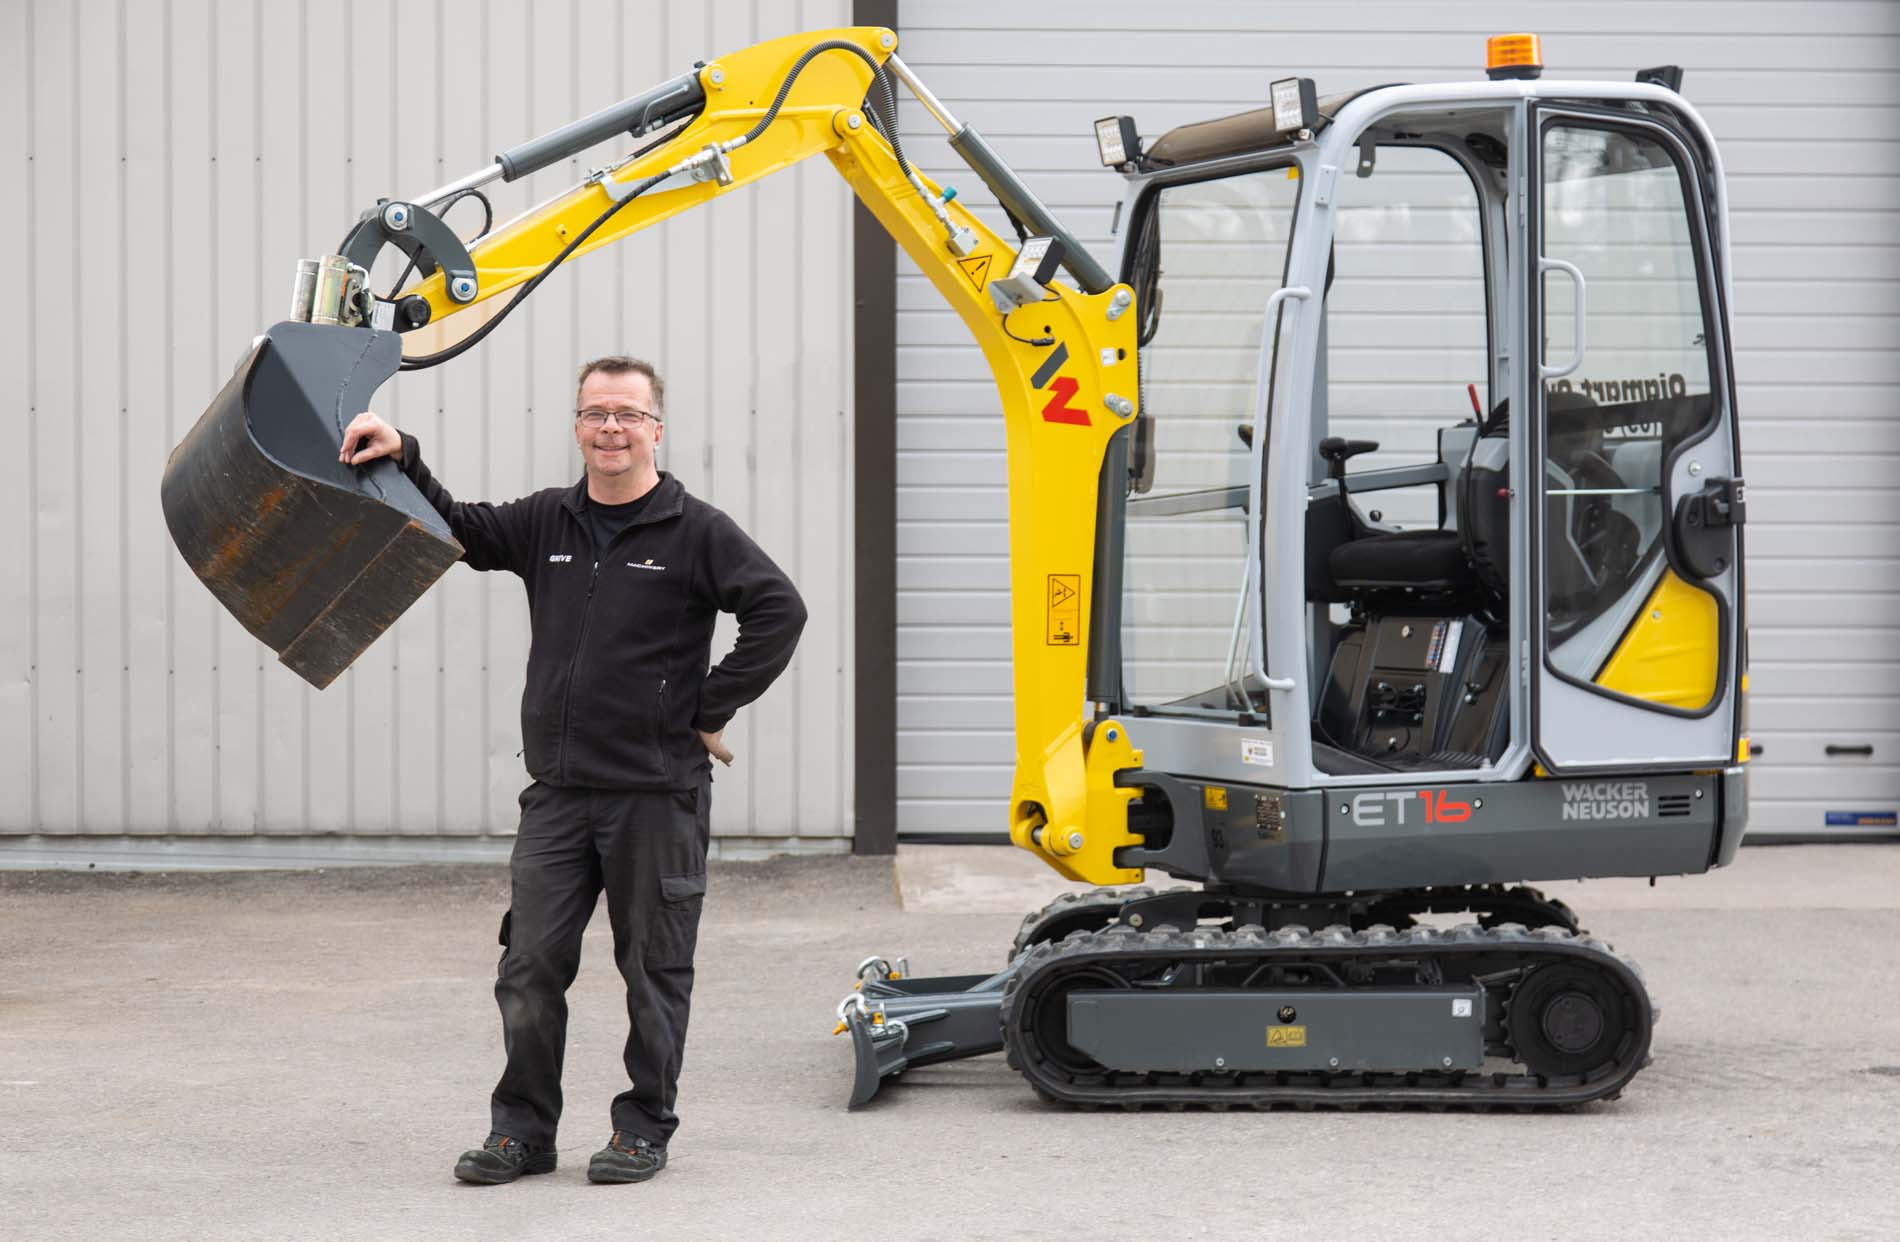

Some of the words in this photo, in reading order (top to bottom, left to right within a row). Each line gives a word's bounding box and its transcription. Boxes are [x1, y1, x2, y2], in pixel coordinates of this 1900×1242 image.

[1561, 783, 1649, 801] WACKER
[1353, 789, 1472, 826] ET16
[1562, 801, 1650, 820] NEUSON
